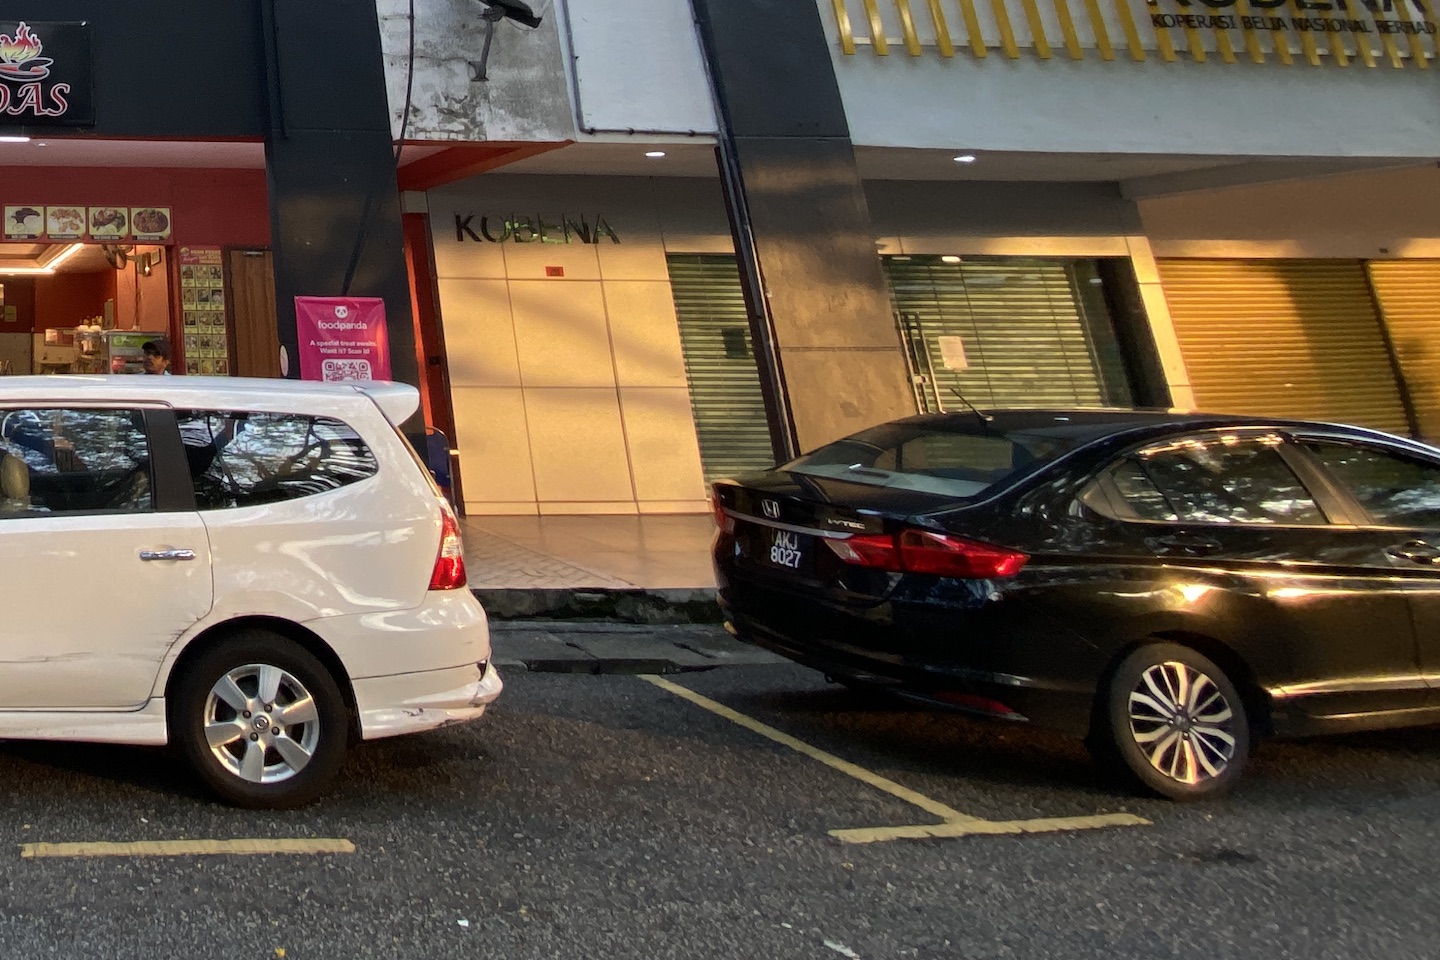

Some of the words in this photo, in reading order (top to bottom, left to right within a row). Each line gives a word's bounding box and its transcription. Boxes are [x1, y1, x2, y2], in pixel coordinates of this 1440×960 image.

[1151, 13, 1238, 30] KOPERASI
[1241, 15, 1289, 31] BELIA
[1291, 18, 1373, 33] NASIONAL
[454, 209, 622, 244] KOBENA
[318, 320, 368, 332] foodpanda
[317, 340, 339, 348] special
[774, 530, 798, 550] AKJ
[770, 545, 802, 569] 8027
